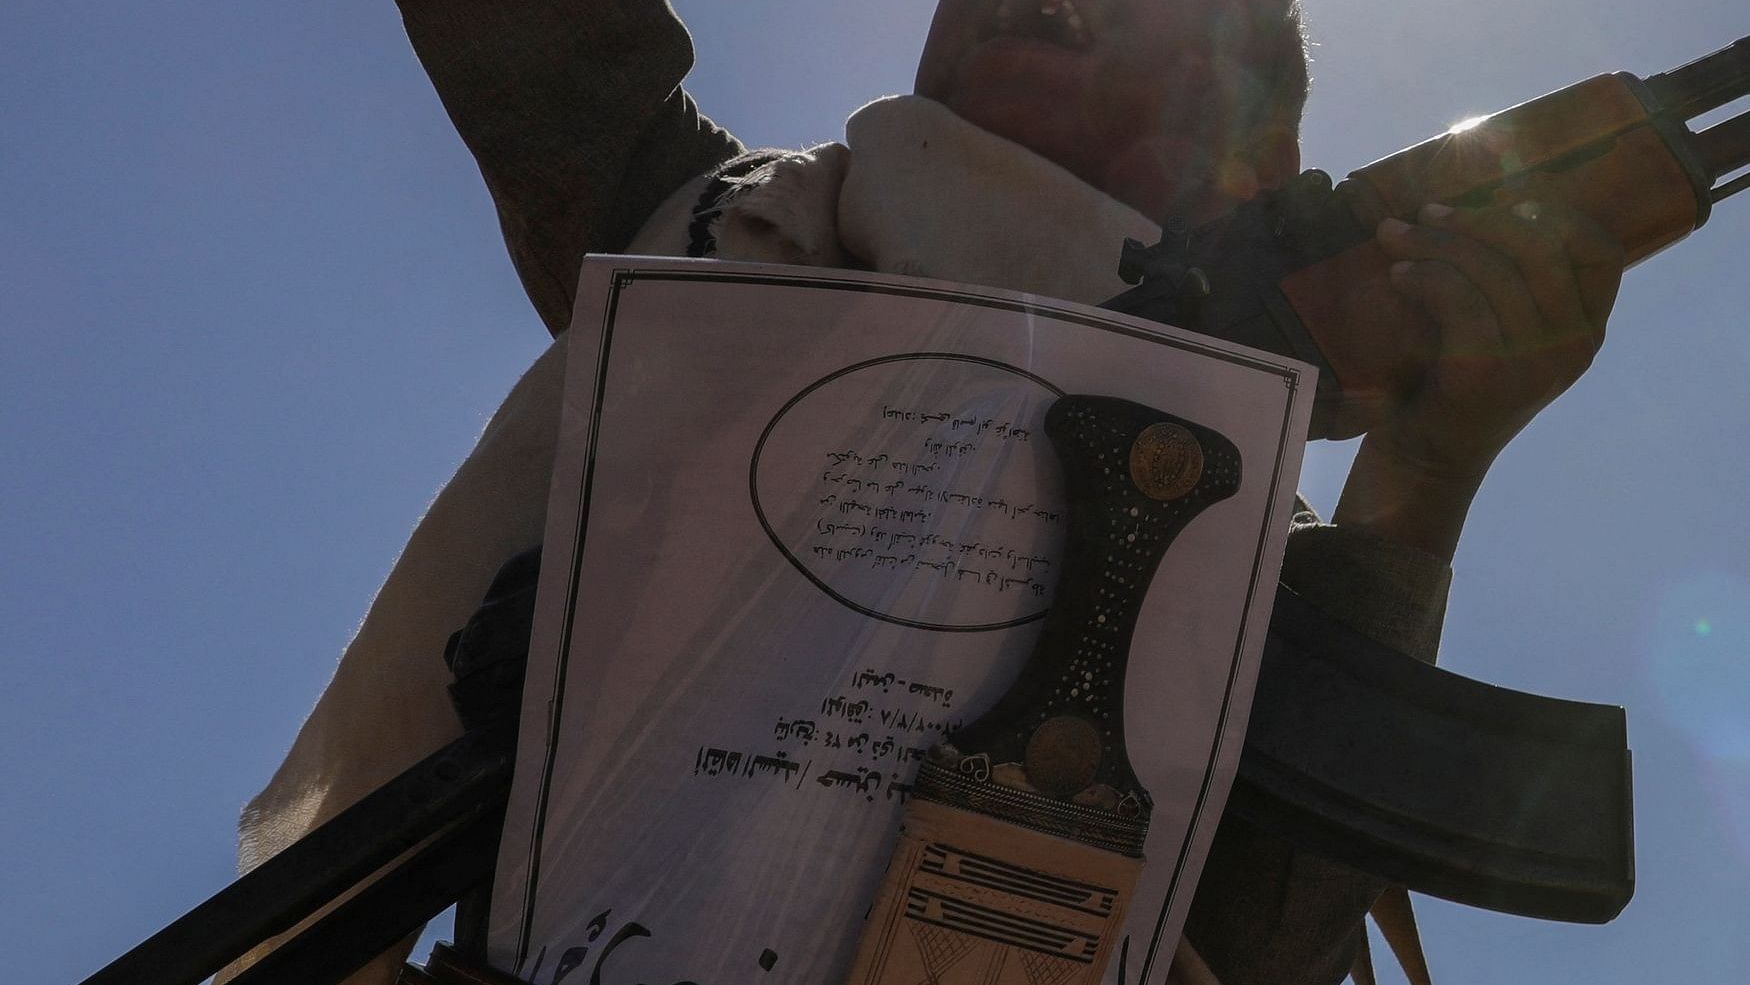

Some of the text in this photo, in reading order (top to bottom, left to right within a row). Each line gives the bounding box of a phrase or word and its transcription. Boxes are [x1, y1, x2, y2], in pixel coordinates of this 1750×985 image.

[882, 405, 915, 422] إعداد:
[919, 413, 951, 424] يحيى
[951, 415, 977, 430] قاسم
[976, 419, 993, 436] أبو
[826, 450, 862, 466] مكتوبة
[867, 454, 888, 470] على
[892, 462, 909, 474] هذا
[924, 437, 942, 459] والله
[819, 495, 837, 506] من
[839, 500, 872, 516] اللهجة
[875, 506, 898, 519] المحلية
[885, 481, 904, 495] على
[908, 485, 934, 502] سهولة
[937, 490, 983, 508] الاستفادة
[988, 501, 1007, 514] منها
[871, 526, 887, 542] وقد
[813, 547, 832, 558] هذه
[837, 548, 873, 562] الدروس
[901, 555, 915, 564] من
[958, 569, 980, 583] لها
[986, 570, 998, 585] في
[999, 576, 1046, 597] أشرطة
[851, 668, 896, 694] اليمن
[908, 682, 954, 709] صعدة
[820, 696, 873, 725] الموافق:
[774, 716, 820, 747] بتاريخ:
[823, 732, 840, 749] ٢٤
[847, 733, 869, 754] من
[872, 736, 894, 762] ذي
[694, 745, 743, 777] ألقاها
[815, 767, 881, 803] حسين
